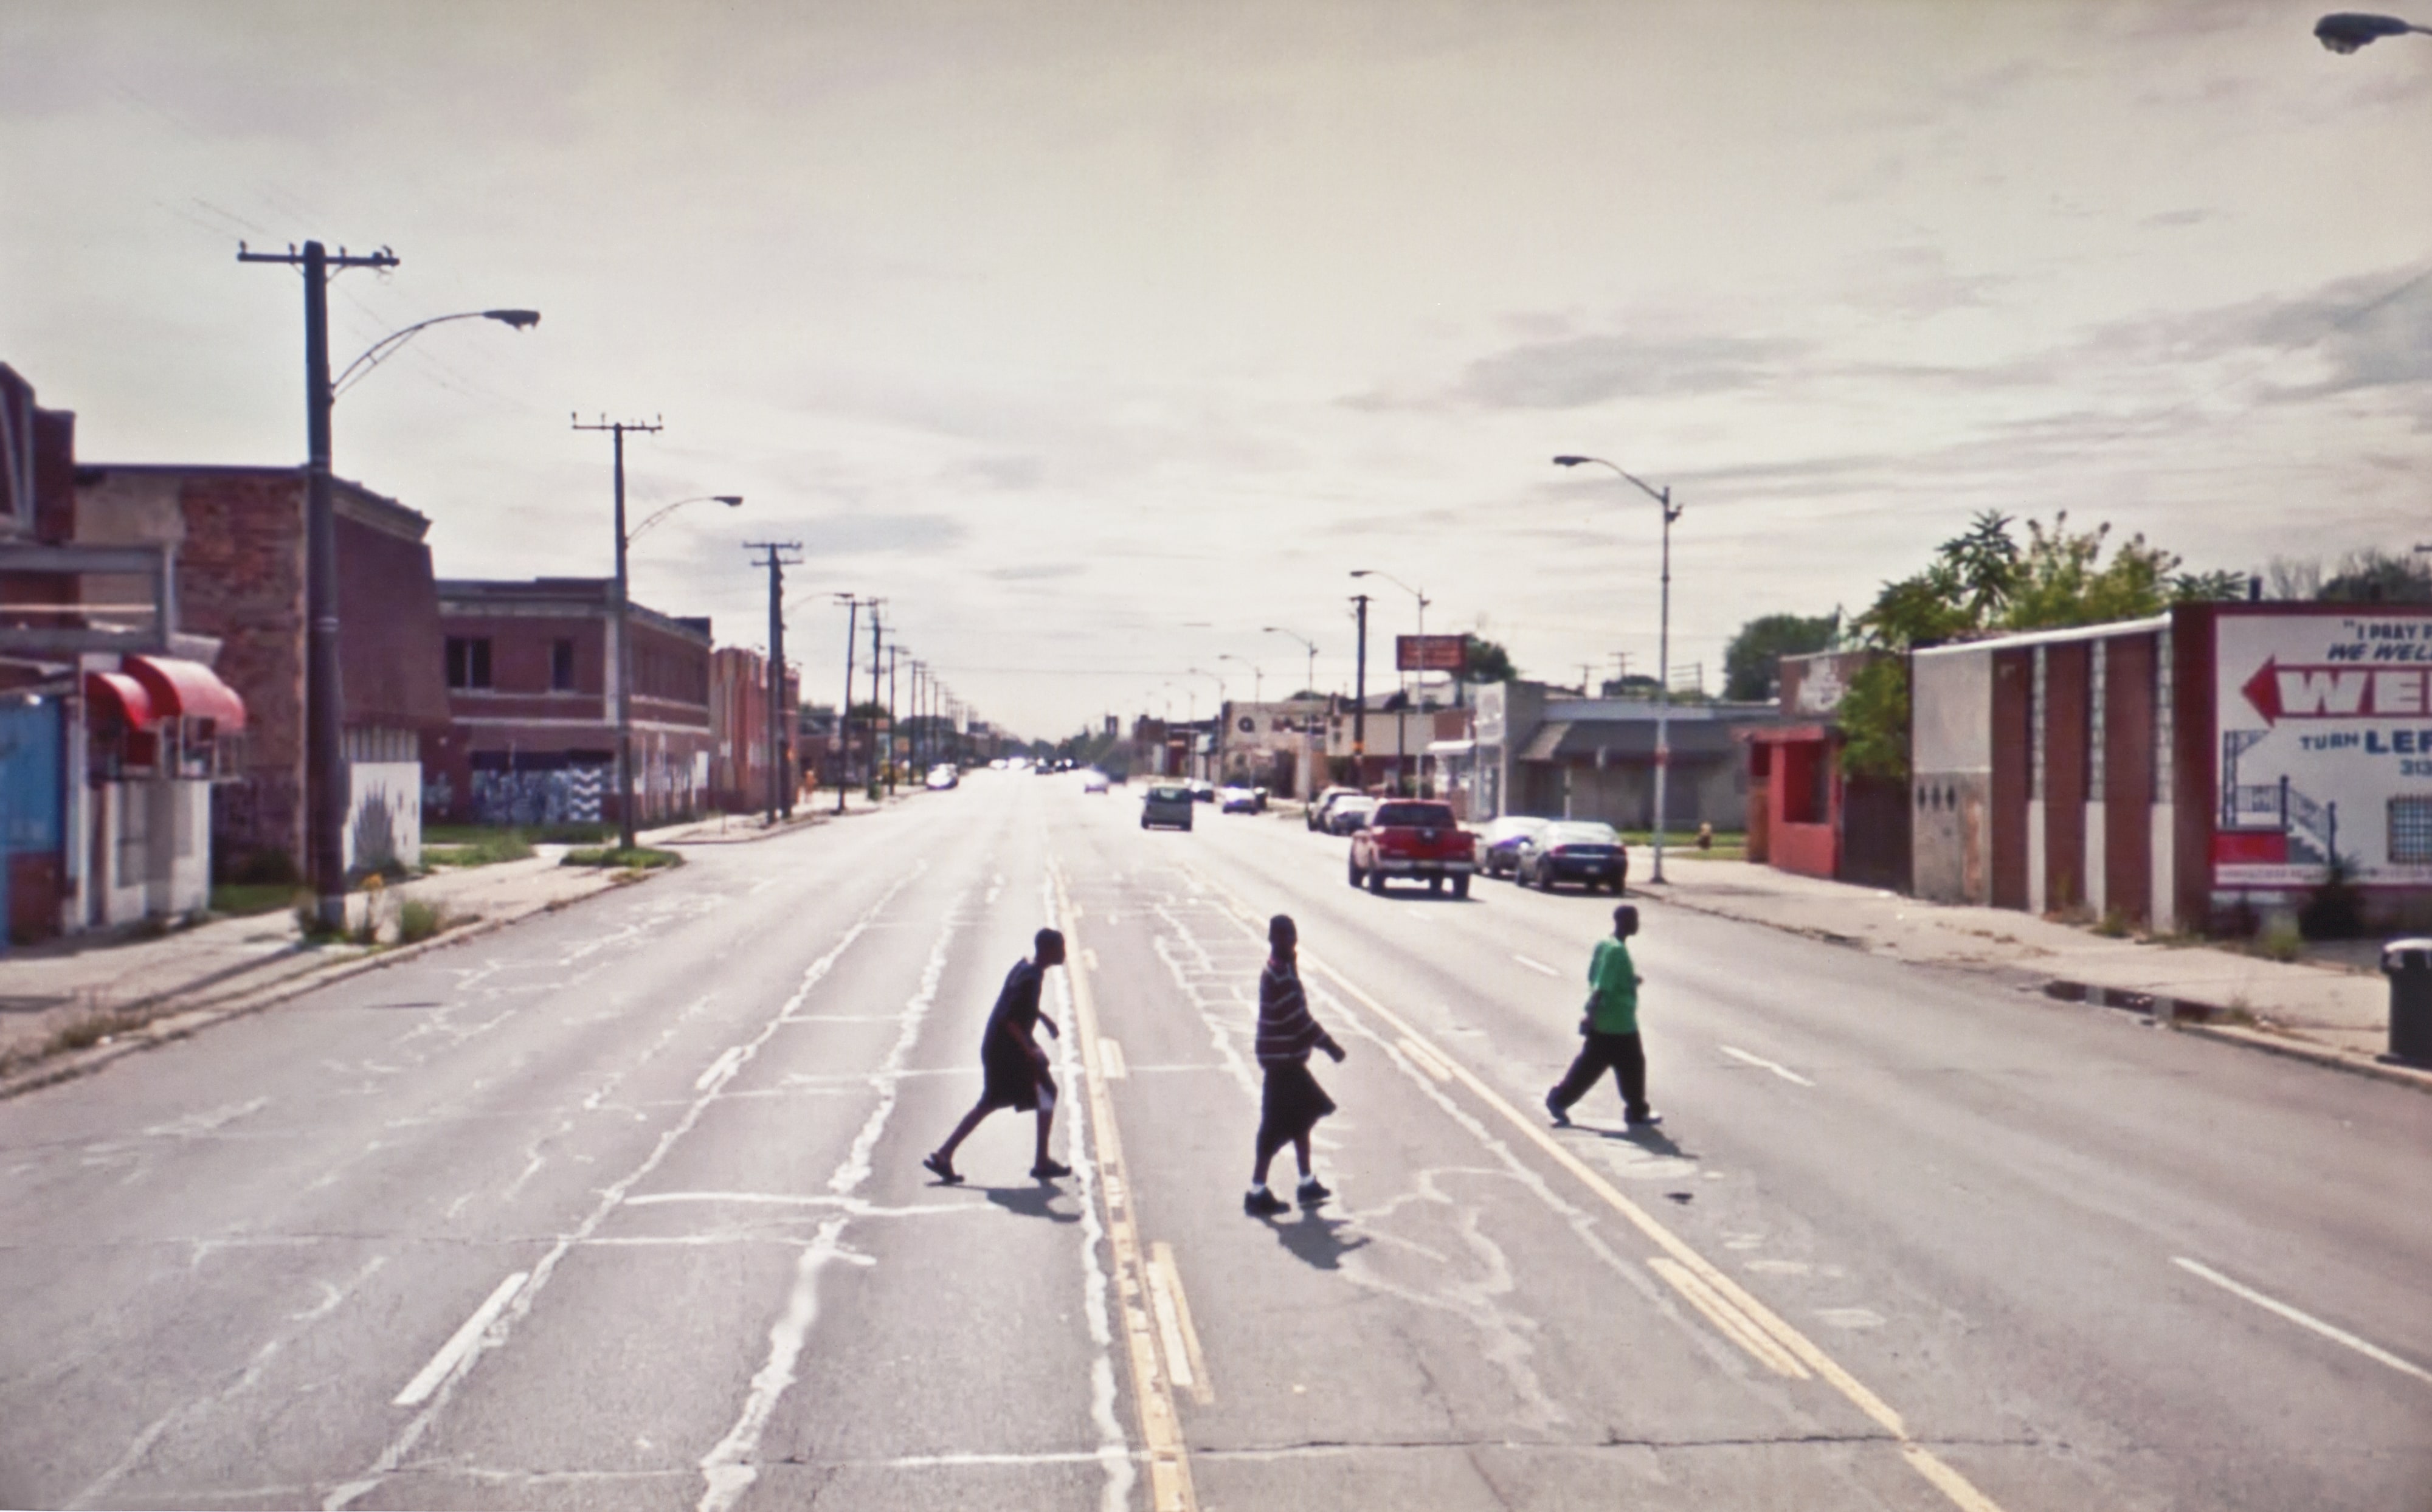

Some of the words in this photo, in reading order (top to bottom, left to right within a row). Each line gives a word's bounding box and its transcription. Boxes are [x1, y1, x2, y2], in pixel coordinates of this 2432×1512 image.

[2369, 623, 2417, 640] PRAY
[2327, 643, 2367, 661] WE
[2373, 643, 2432, 661] WEL
[2276, 670, 2432, 714] WE
[2300, 733, 2360, 750] TURN
